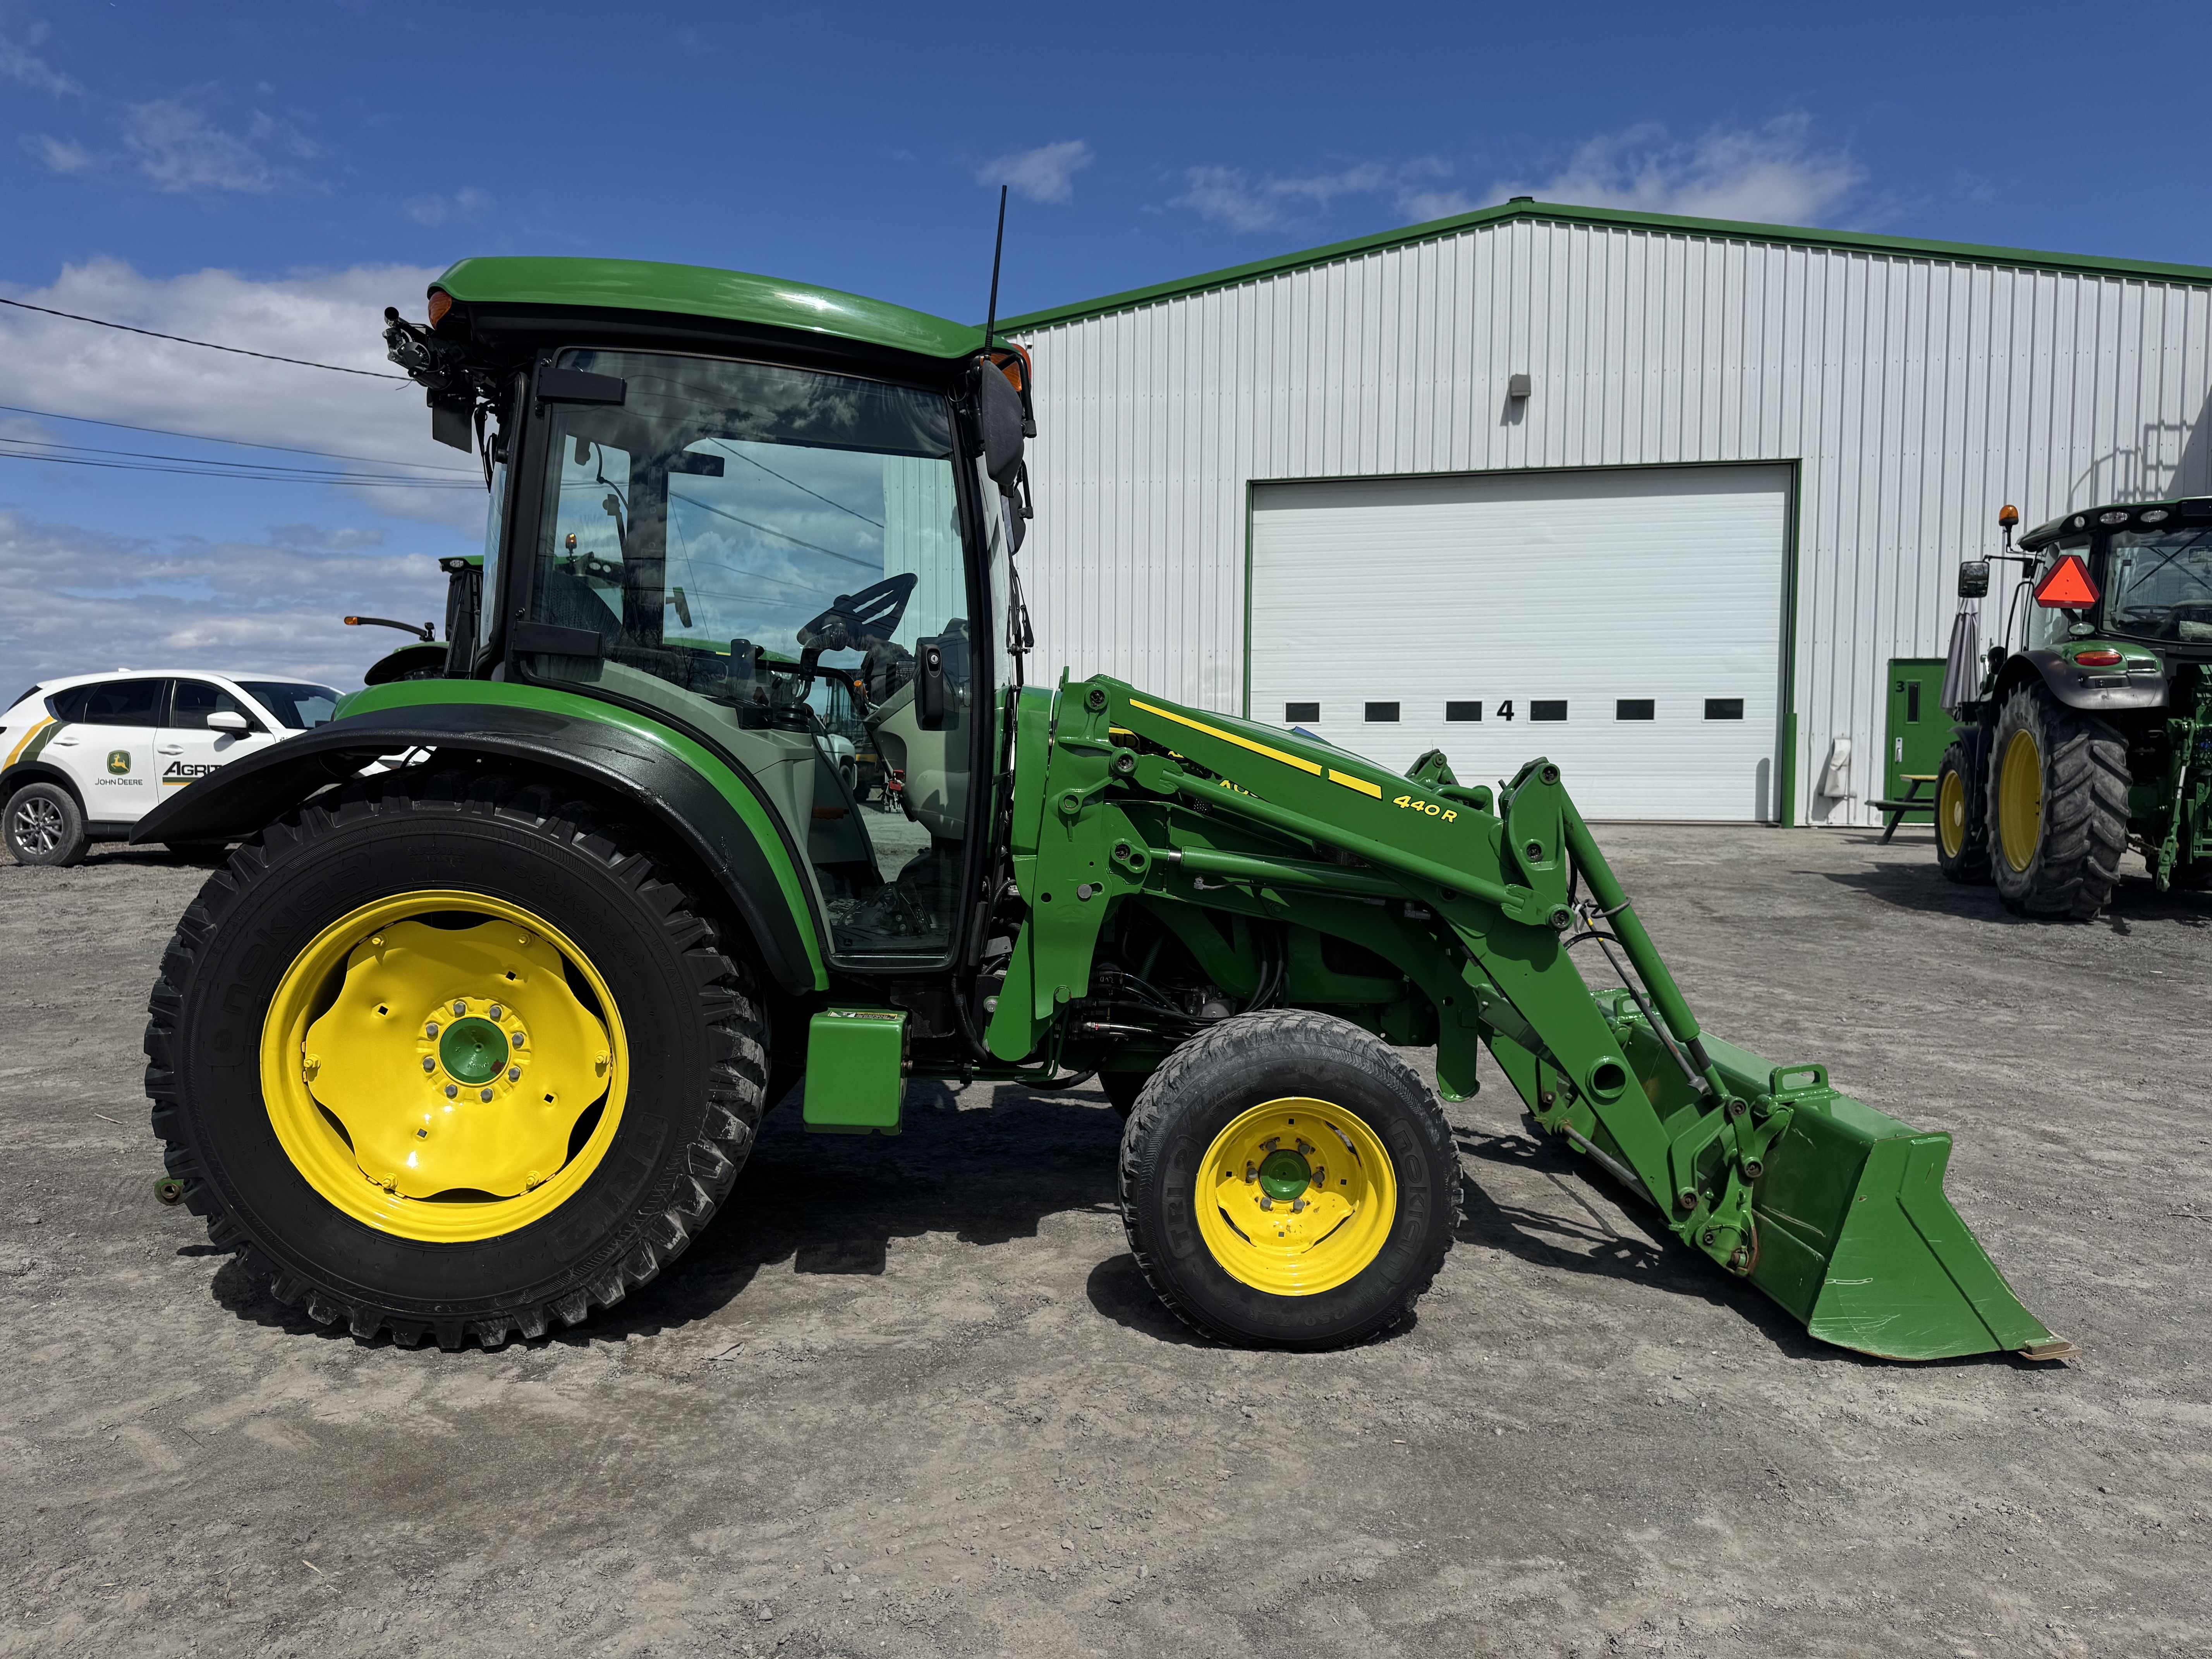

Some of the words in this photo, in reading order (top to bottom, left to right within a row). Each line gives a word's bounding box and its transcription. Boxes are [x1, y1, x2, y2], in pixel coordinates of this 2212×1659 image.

[1896, 681, 1905, 692] 3
[1497, 700, 1514, 721] 4
[211, 889, 264, 958] ROTATION
[651, 939, 691, 1014] ROTATION
[1209, 1082, 1262, 1120] STEEL
[1174, 1148, 1194, 1170] 2
[1167, 1187, 1190, 1249] TRI
